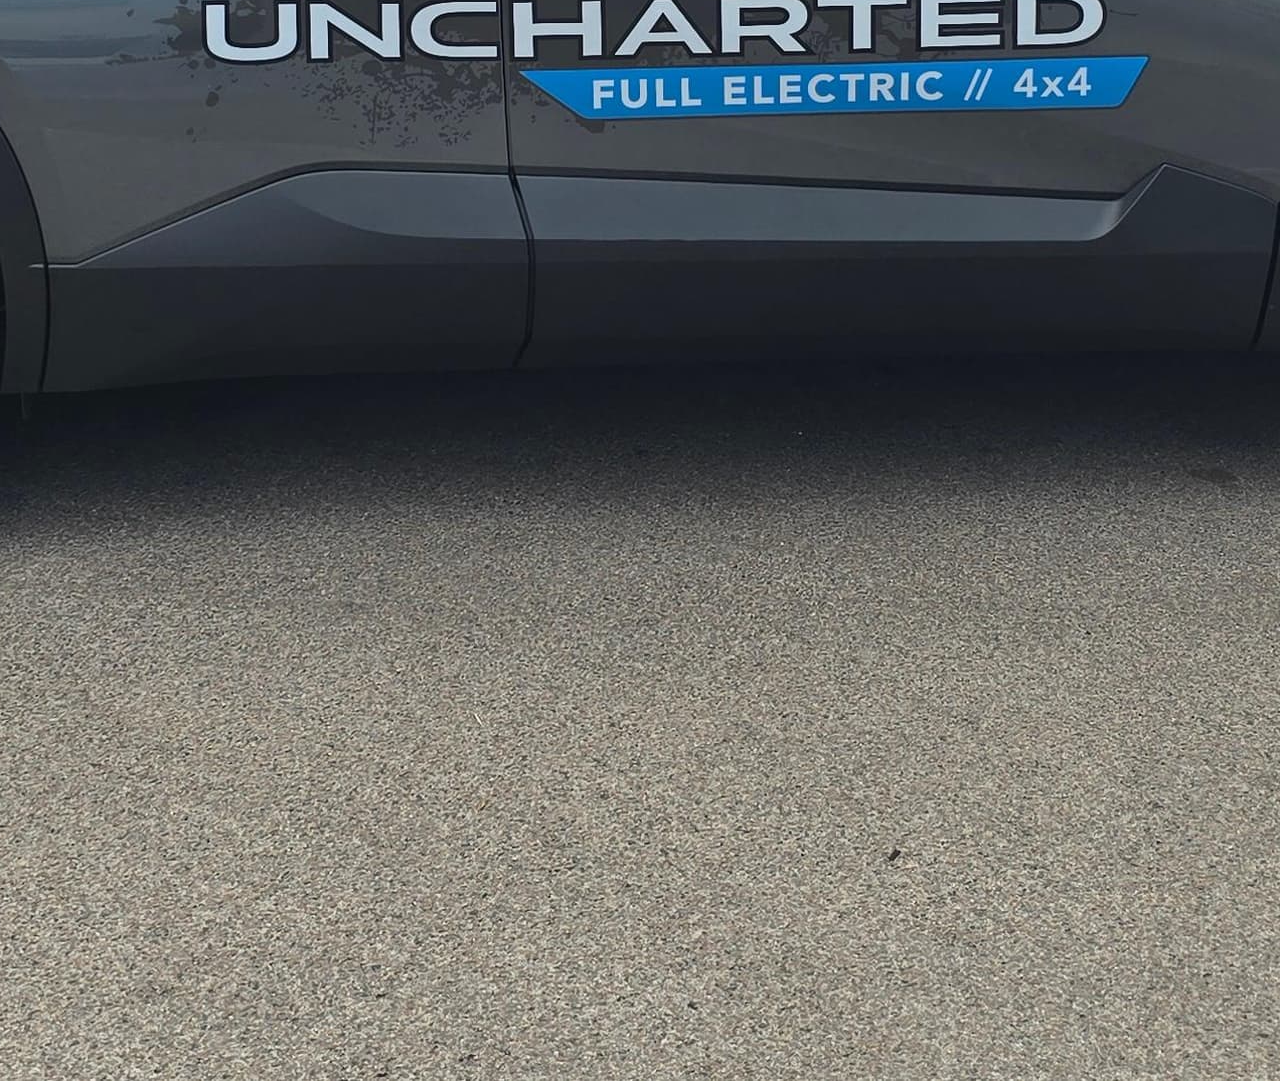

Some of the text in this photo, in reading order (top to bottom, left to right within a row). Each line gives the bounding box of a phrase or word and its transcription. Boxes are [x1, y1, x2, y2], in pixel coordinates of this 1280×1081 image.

[592, 77, 702, 110] FULL
[722, 71, 945, 107] ELECTRIC
[1012, 66, 1093, 99] 4x4
